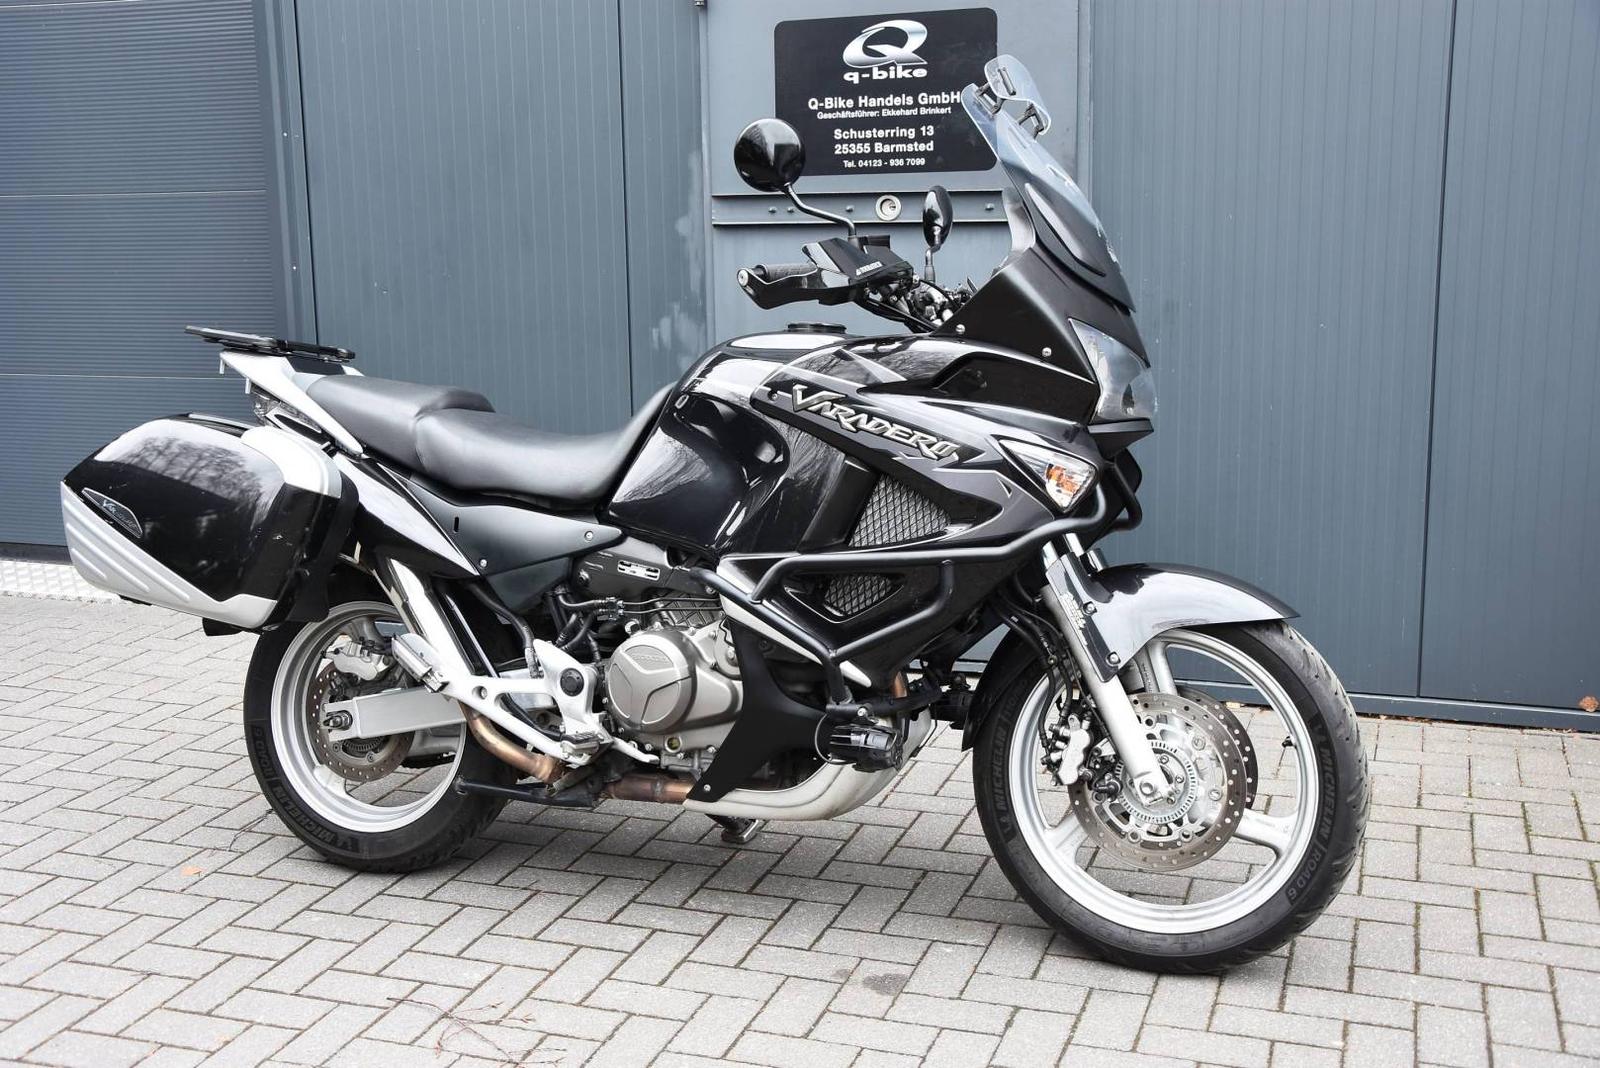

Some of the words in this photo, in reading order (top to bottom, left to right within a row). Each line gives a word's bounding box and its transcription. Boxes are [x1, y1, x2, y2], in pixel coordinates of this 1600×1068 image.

[843, 67, 928, 84] q-bike
[808, 97, 854, 110] Q-Bike
[858, 94, 914, 108] Handels
[918, 91, 961, 105] GmbH
[881, 108, 918, 117] Ekkehard
[919, 106, 951, 115] Brinkert
[834, 127, 916, 141] Schusterring
[920, 125, 934, 137] 13
[834, 143, 871, 155] 25355
[843, 160, 857, 168] Tel.
[858, 158, 882, 167] 04123
[889, 158, 904, 167] 936
[906, 158, 926, 166] 7099
[792, 384, 960, 461] VARADERO
[1318, 747, 1336, 841] MICHELIN
[272, 780, 335, 843] MICHELIN
[1296, 848, 1322, 889] ROAD
